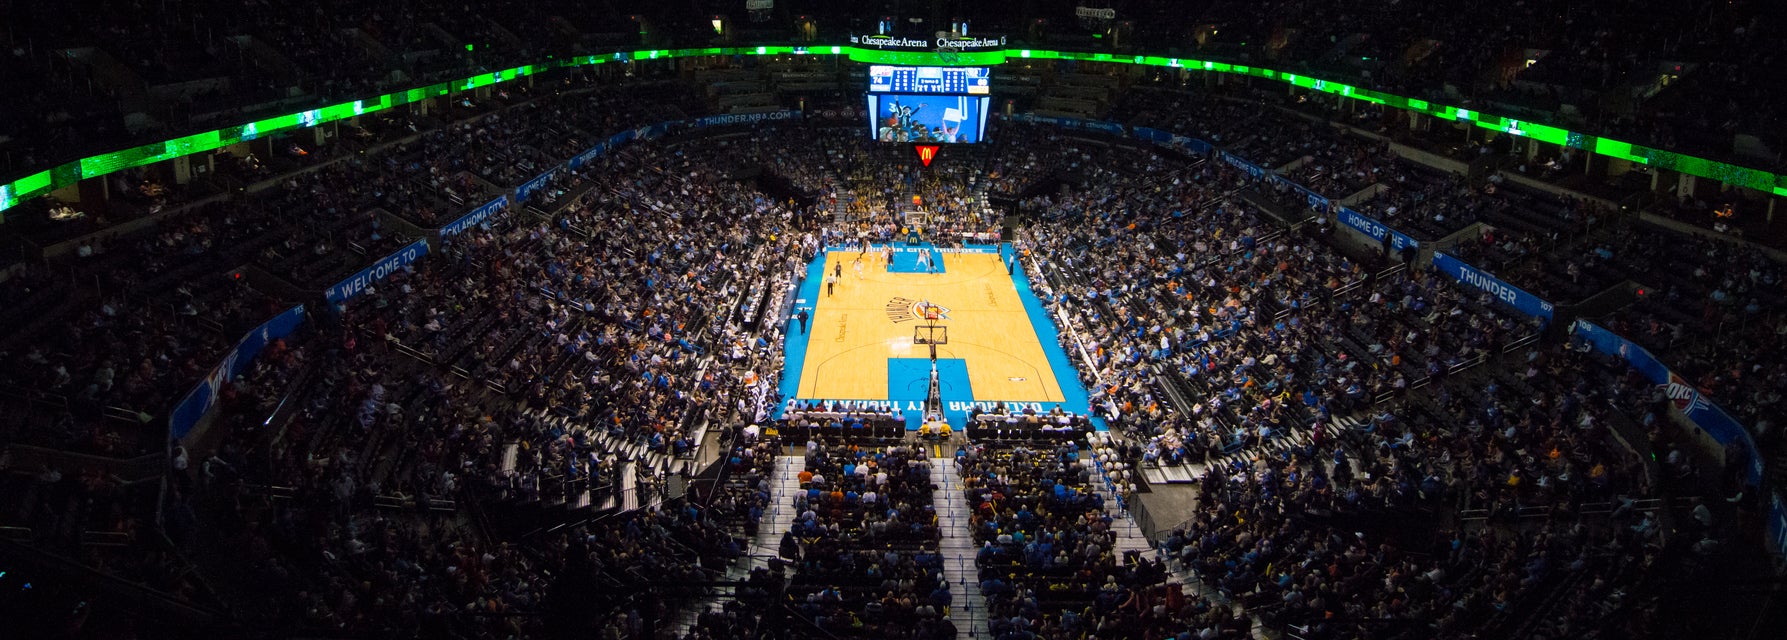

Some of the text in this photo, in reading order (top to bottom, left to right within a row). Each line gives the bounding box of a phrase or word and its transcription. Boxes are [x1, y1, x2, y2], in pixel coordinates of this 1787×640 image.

[862, 35, 900, 49] Chesapeake
[901, 37, 928, 48] Arena
[936, 37, 981, 51] Chesapeake
[982, 37, 999, 47] Arena
[873, 76, 883, 84] 74
[1250, 166, 1258, 177] TO
[488, 200, 503, 216] CITY
[1348, 213, 1372, 233] HOME
[1372, 225, 1385, 238] OF
[341, 256, 401, 299] WELCOME
[402, 248, 416, 264] TO
[1459, 266, 1517, 305] THUNDER
[1540, 301, 1553, 312] 107
[1579, 319, 1592, 332] 108
[1665, 382, 1694, 400] OKC
